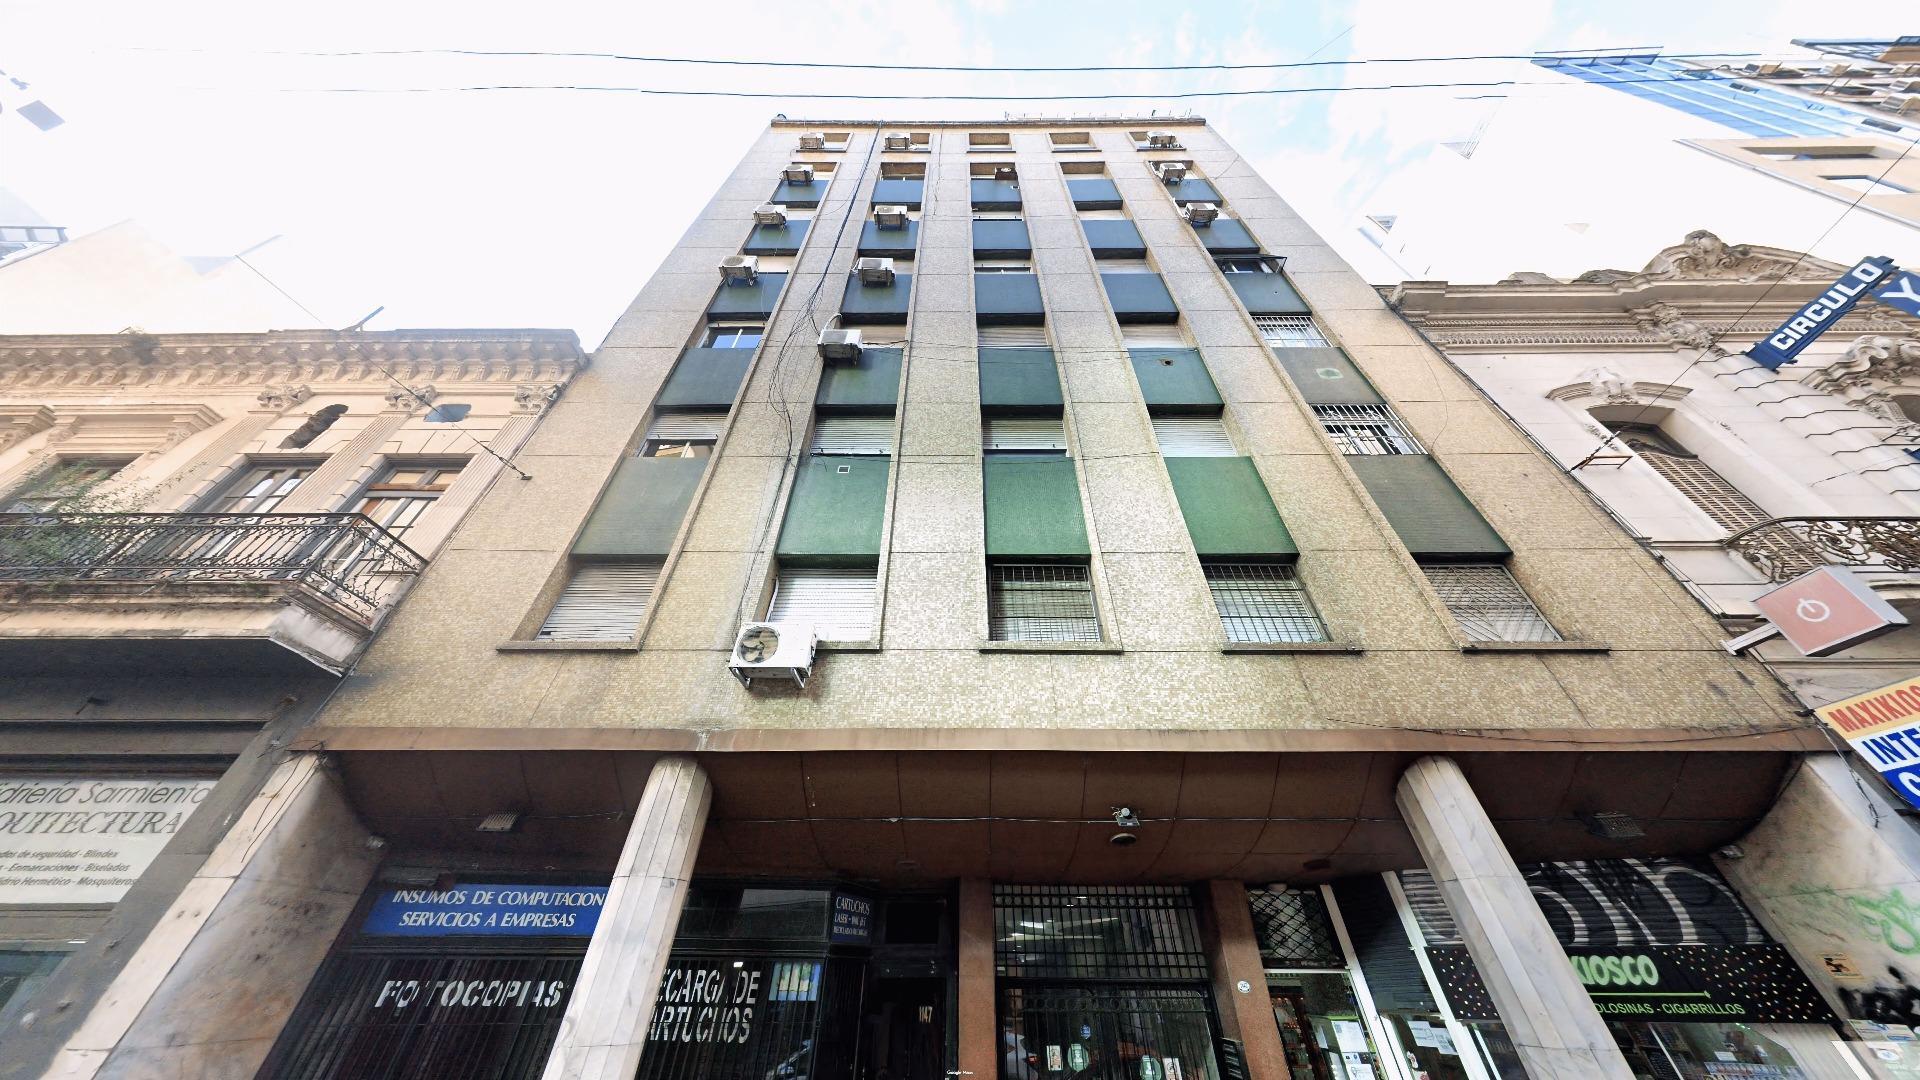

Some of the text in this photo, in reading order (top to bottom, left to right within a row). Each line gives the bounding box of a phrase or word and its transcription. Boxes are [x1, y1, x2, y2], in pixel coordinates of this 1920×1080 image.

[1769, 262, 1883, 351] CIRCULO
[79, 782, 211, 805] Sarmiento
[83, 850, 118, 858] Blindex
[8, 863, 78, 872] Enmarcaciones
[84, 863, 130, 872] Biselados
[393, 889, 605, 907] INSUMOS DE COMPUTACION
[836, 896, 870, 915] CARTUCHOS
[399, 911, 577, 928] SERVICIOS A EMPRESAS
[374, 980, 564, 1008] FOTOCOPIAS
[733, 971, 761, 1005] DE
[1662, 1003, 1746, 1015] CIGARRILLOS
